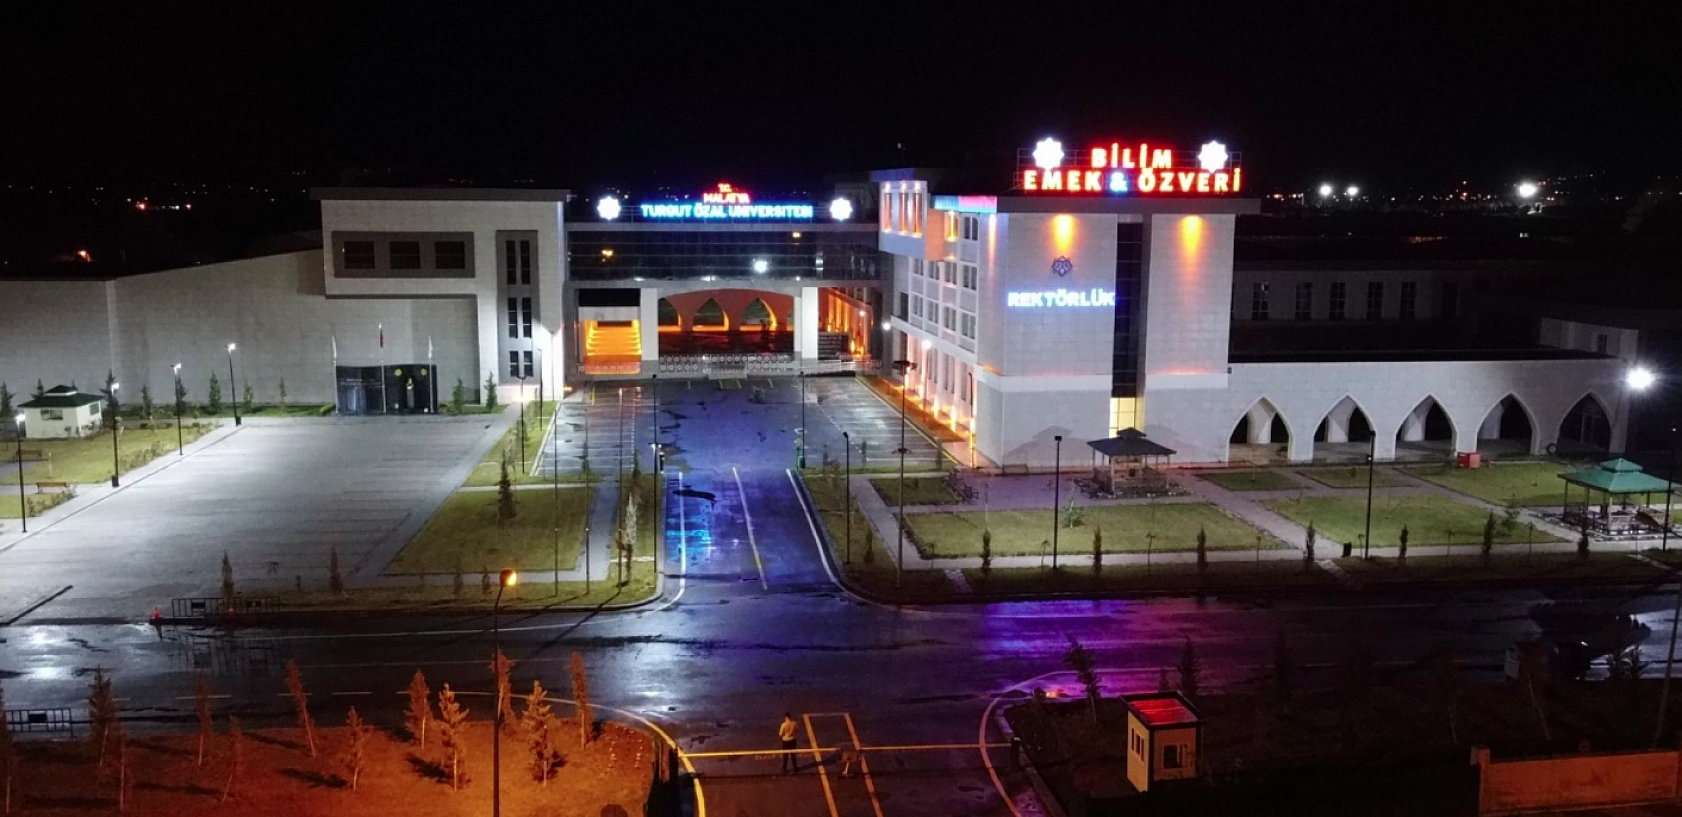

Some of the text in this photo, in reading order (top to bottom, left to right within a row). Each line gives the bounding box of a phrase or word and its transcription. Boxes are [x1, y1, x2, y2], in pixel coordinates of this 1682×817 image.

[1091, 143, 1172, 169] BİLİM
[1024, 168, 1241, 192] EMEK & ÖZVERİ
[704, 193, 750, 204] MALATYA
[641, 204, 693, 218] TURGUT
[694, 203, 727, 218] ÖZAL
[1008, 289, 1115, 306] REKTÖRLÜK
